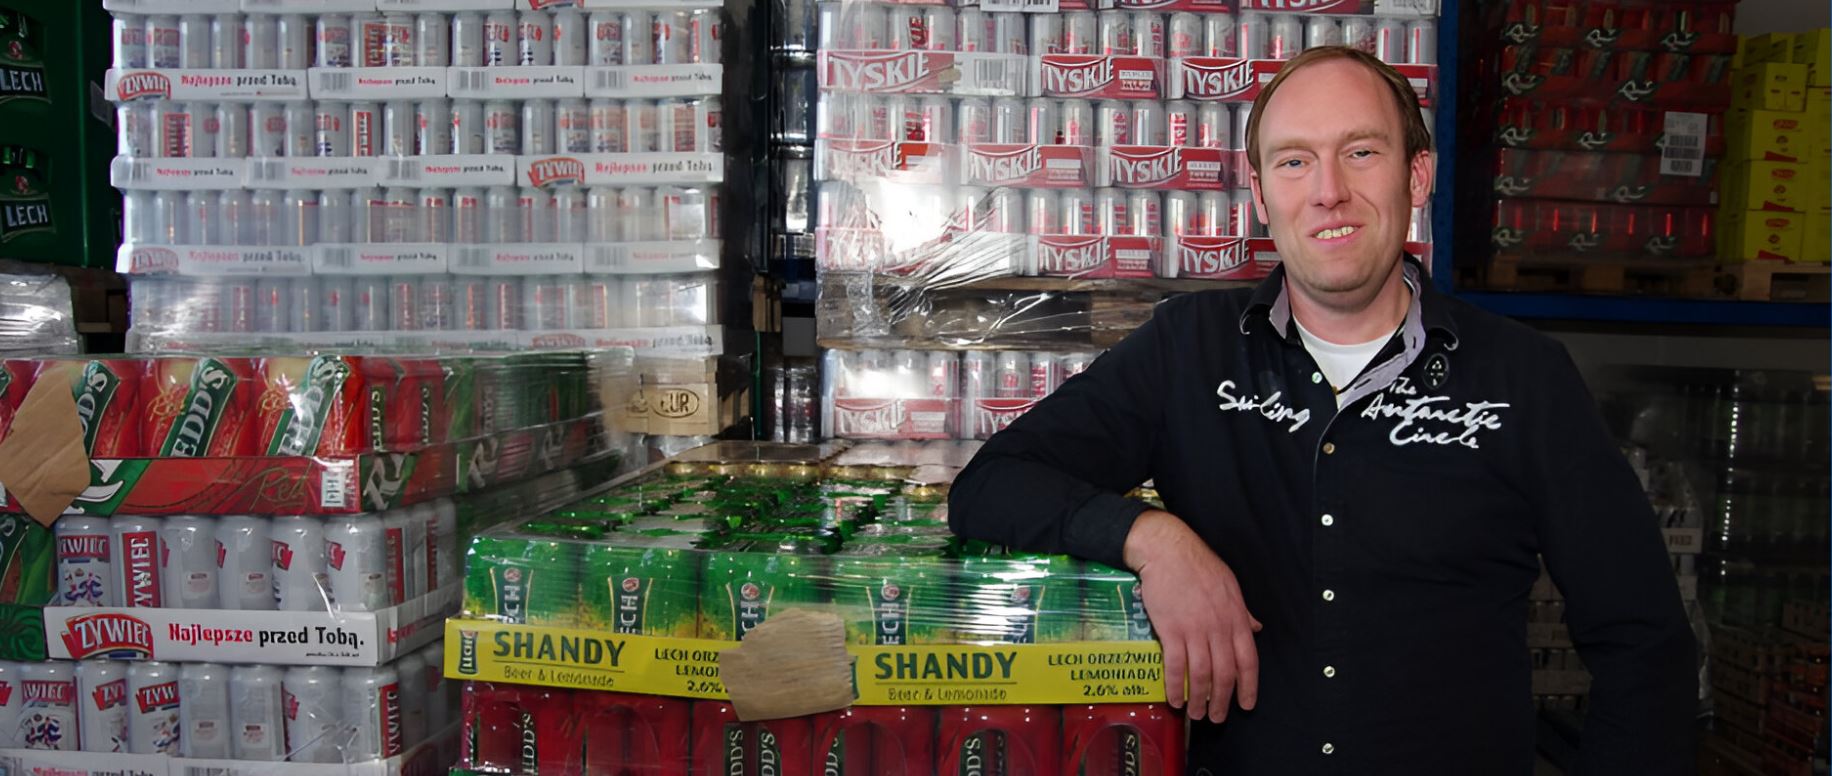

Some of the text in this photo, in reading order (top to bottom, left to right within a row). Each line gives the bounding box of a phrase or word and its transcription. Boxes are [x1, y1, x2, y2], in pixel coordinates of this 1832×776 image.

[0, 68, 43, 92] LECH
[828, 53, 930, 91] TYSKIE
[1043, 56, 1114, 93] TYSKIE
[1185, 58, 1254, 94] TYSKIE
[969, 145, 1042, 182] TYSKIE
[1111, 147, 1182, 184] TYSKIE
[6, 204, 49, 227] LECH
[1039, 235, 1112, 271] TYSKIE
[1180, 238, 1250, 273] TYSKIE
[1389, 377, 1417, 395] The
[170, 367, 230, 456] EDD'S
[1360, 393, 1511, 430] Antarctic
[1389, 420, 1480, 449] Circle
[131, 537, 153, 607] YWIEC
[168, 622, 253, 648] Najlepsze
[259, 625, 309, 650] przed
[315, 627, 365, 651] Tobą.
[494, 631, 626, 667] SHANDY
[875, 651, 1018, 680] SHANDY
